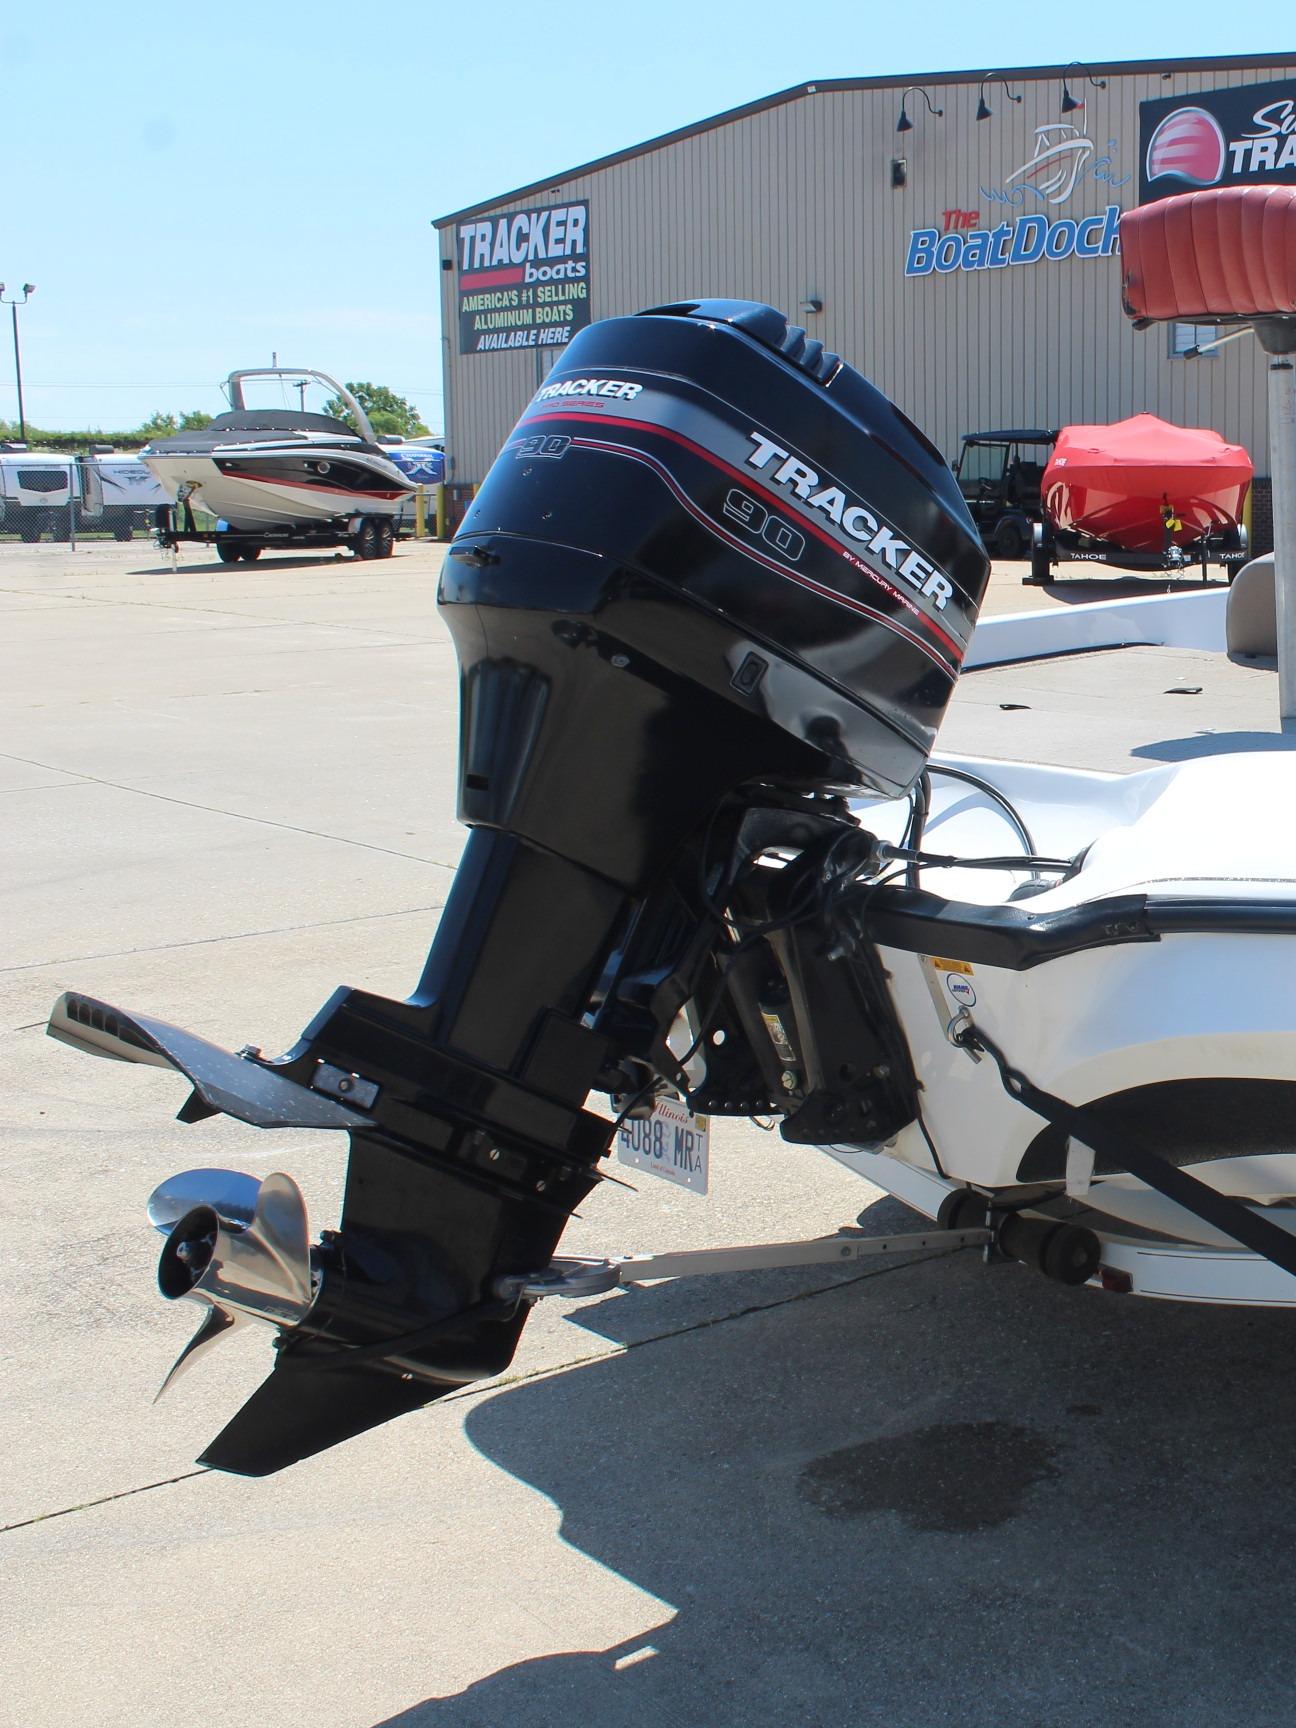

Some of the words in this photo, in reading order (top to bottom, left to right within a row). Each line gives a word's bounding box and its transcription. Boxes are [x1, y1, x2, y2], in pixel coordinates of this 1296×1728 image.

[942, 208, 980, 232] The
[460, 205, 587, 271] TRACKER
[524, 260, 587, 283] boats
[462, 290, 519, 312] AMERICA'S
[521, 288, 533, 305] #1
[537, 282, 587, 303] SELLING
[474, 309, 532, 330] ALUMINUM
[535, 305, 574, 324] BOATS
[477, 330, 537, 351] AVAILABLE
[538, 326, 571, 344] HERE
[537, 379, 643, 402] TRACKER
[515, 434, 572, 460] 90
[722, 488, 806, 562] 90
[750, 431, 955, 612] TRACKER
[1070, 552, 1107, 560] TAHOE
[842, 551, 855, 562] BY
[855, 560, 893, 591] MERCURY
[892, 590, 920, 616] MARINE
